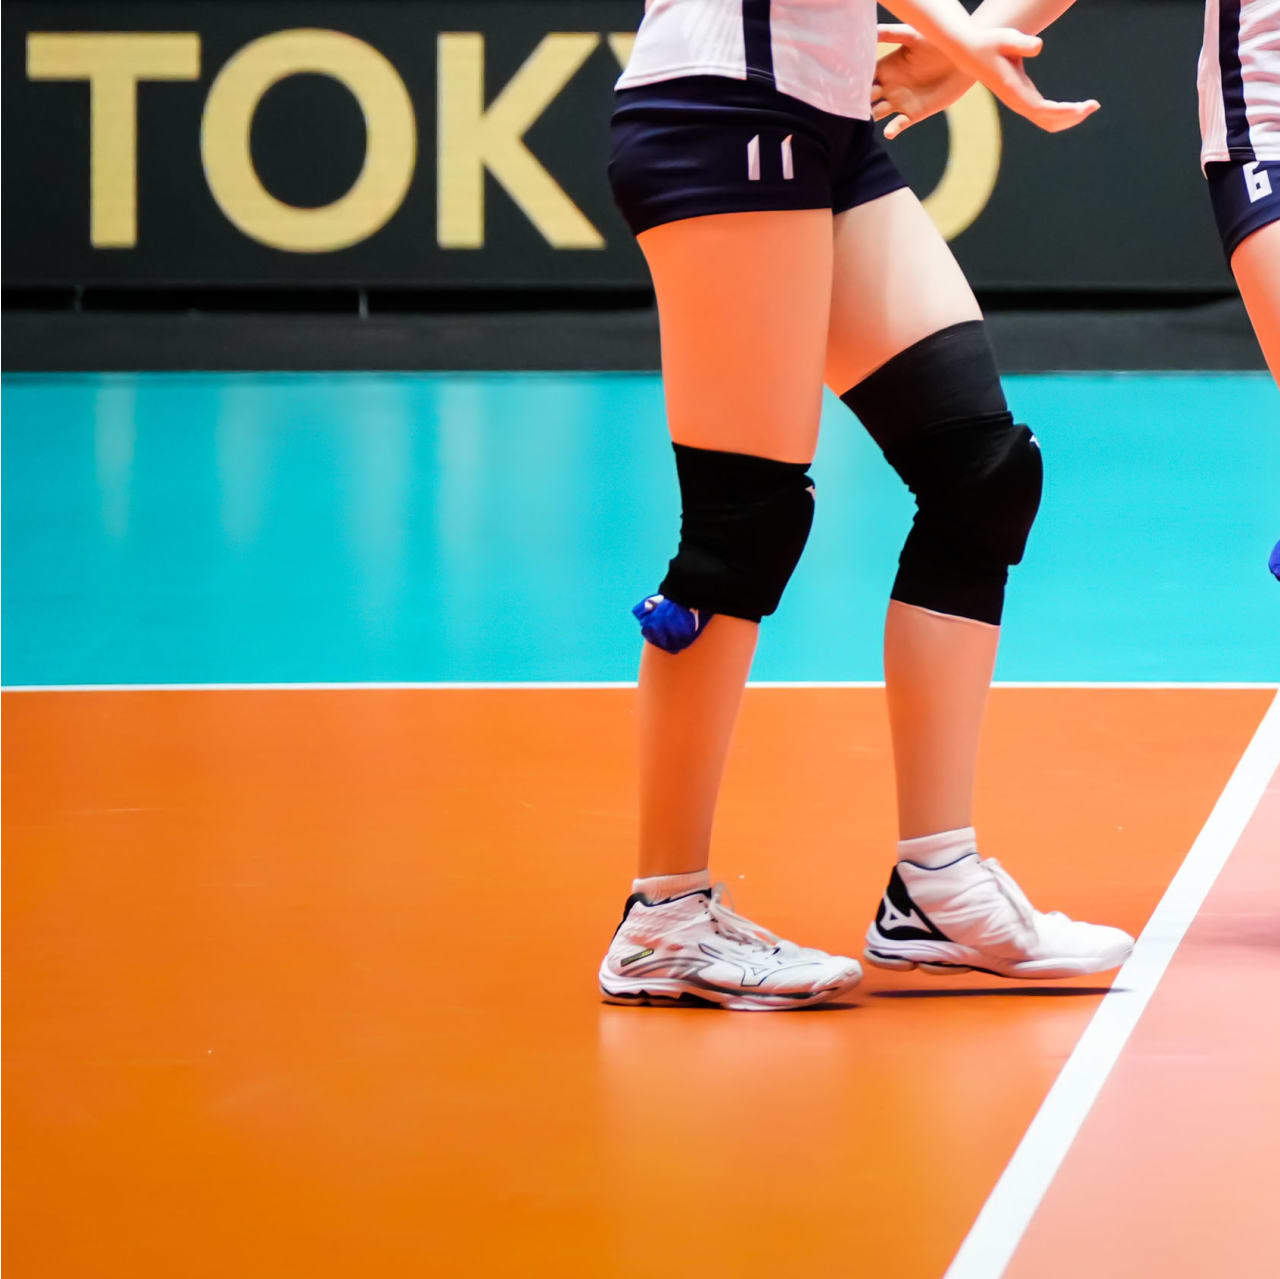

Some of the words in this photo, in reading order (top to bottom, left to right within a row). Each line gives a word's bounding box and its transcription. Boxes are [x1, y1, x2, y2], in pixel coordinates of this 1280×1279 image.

[26, 29, 1003, 254] TOK
[746, 132, 795, 181] 11
[1242, 160, 1273, 204] 6
